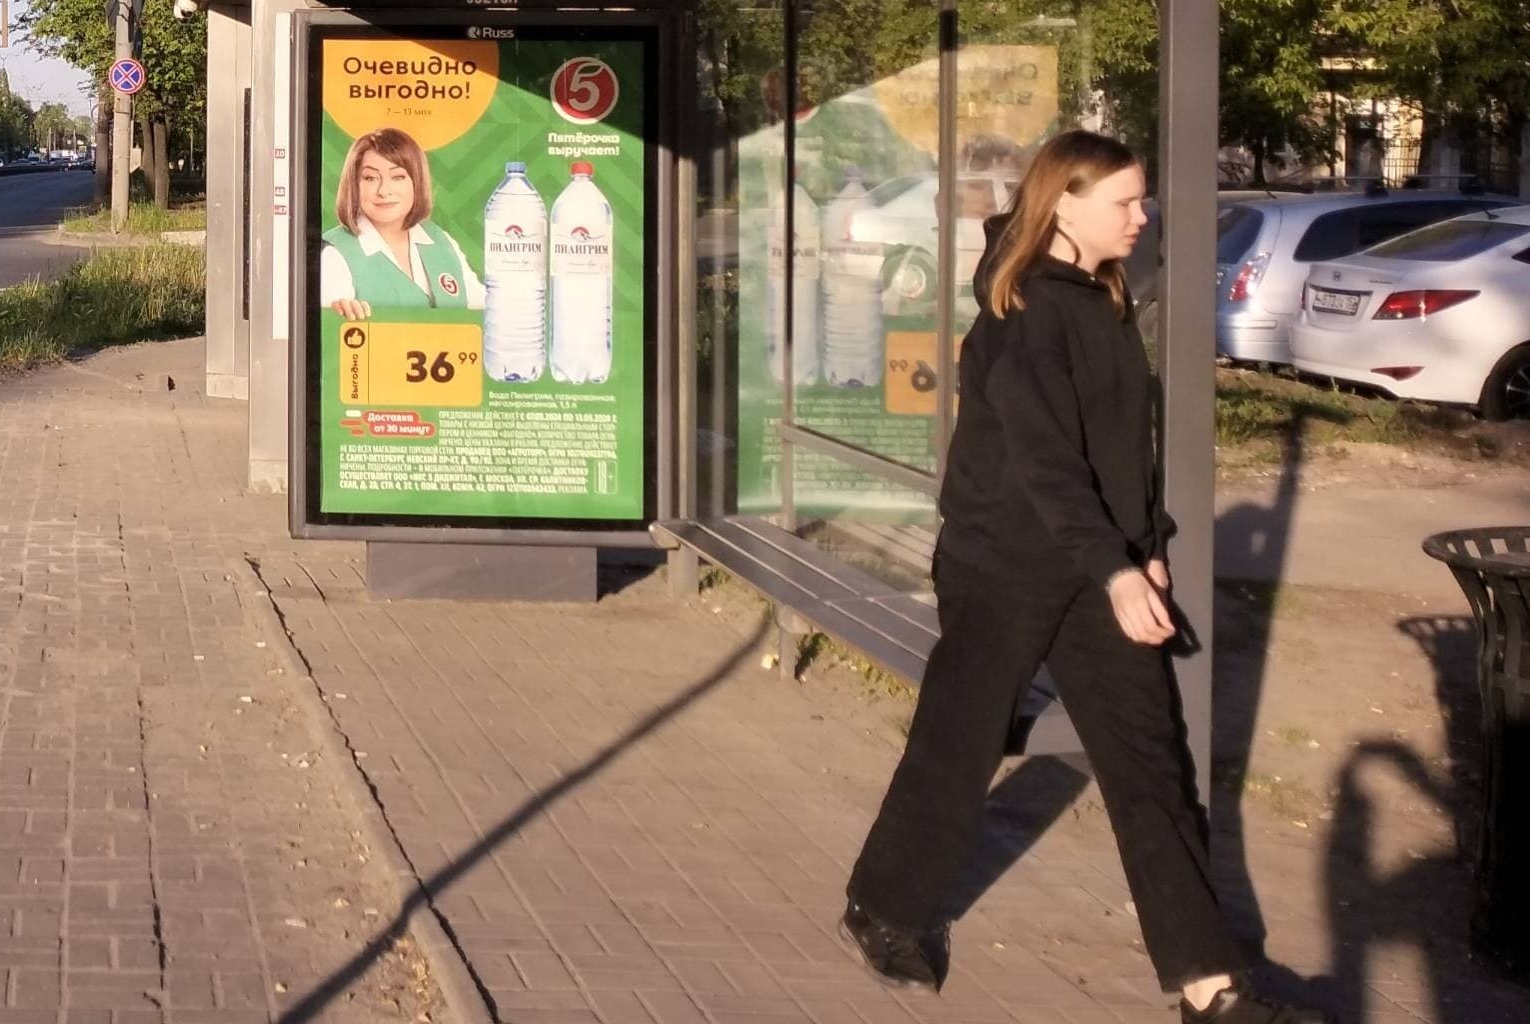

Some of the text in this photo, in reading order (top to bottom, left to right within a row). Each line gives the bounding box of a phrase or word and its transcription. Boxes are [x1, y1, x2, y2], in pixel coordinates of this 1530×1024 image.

[483, 27, 515, 38] Russ
[343, 56, 477, 75] Очевидно
[349, 79, 470, 99] выгодно!
[548, 132, 620, 144] Пятёрочка
[548, 145, 620, 158] выручает!
[406, 350, 478, 383] 36 99
[367, 413, 414, 422] Доставка
[374, 425, 385, 433] от
[400, 425, 431, 436] минут
